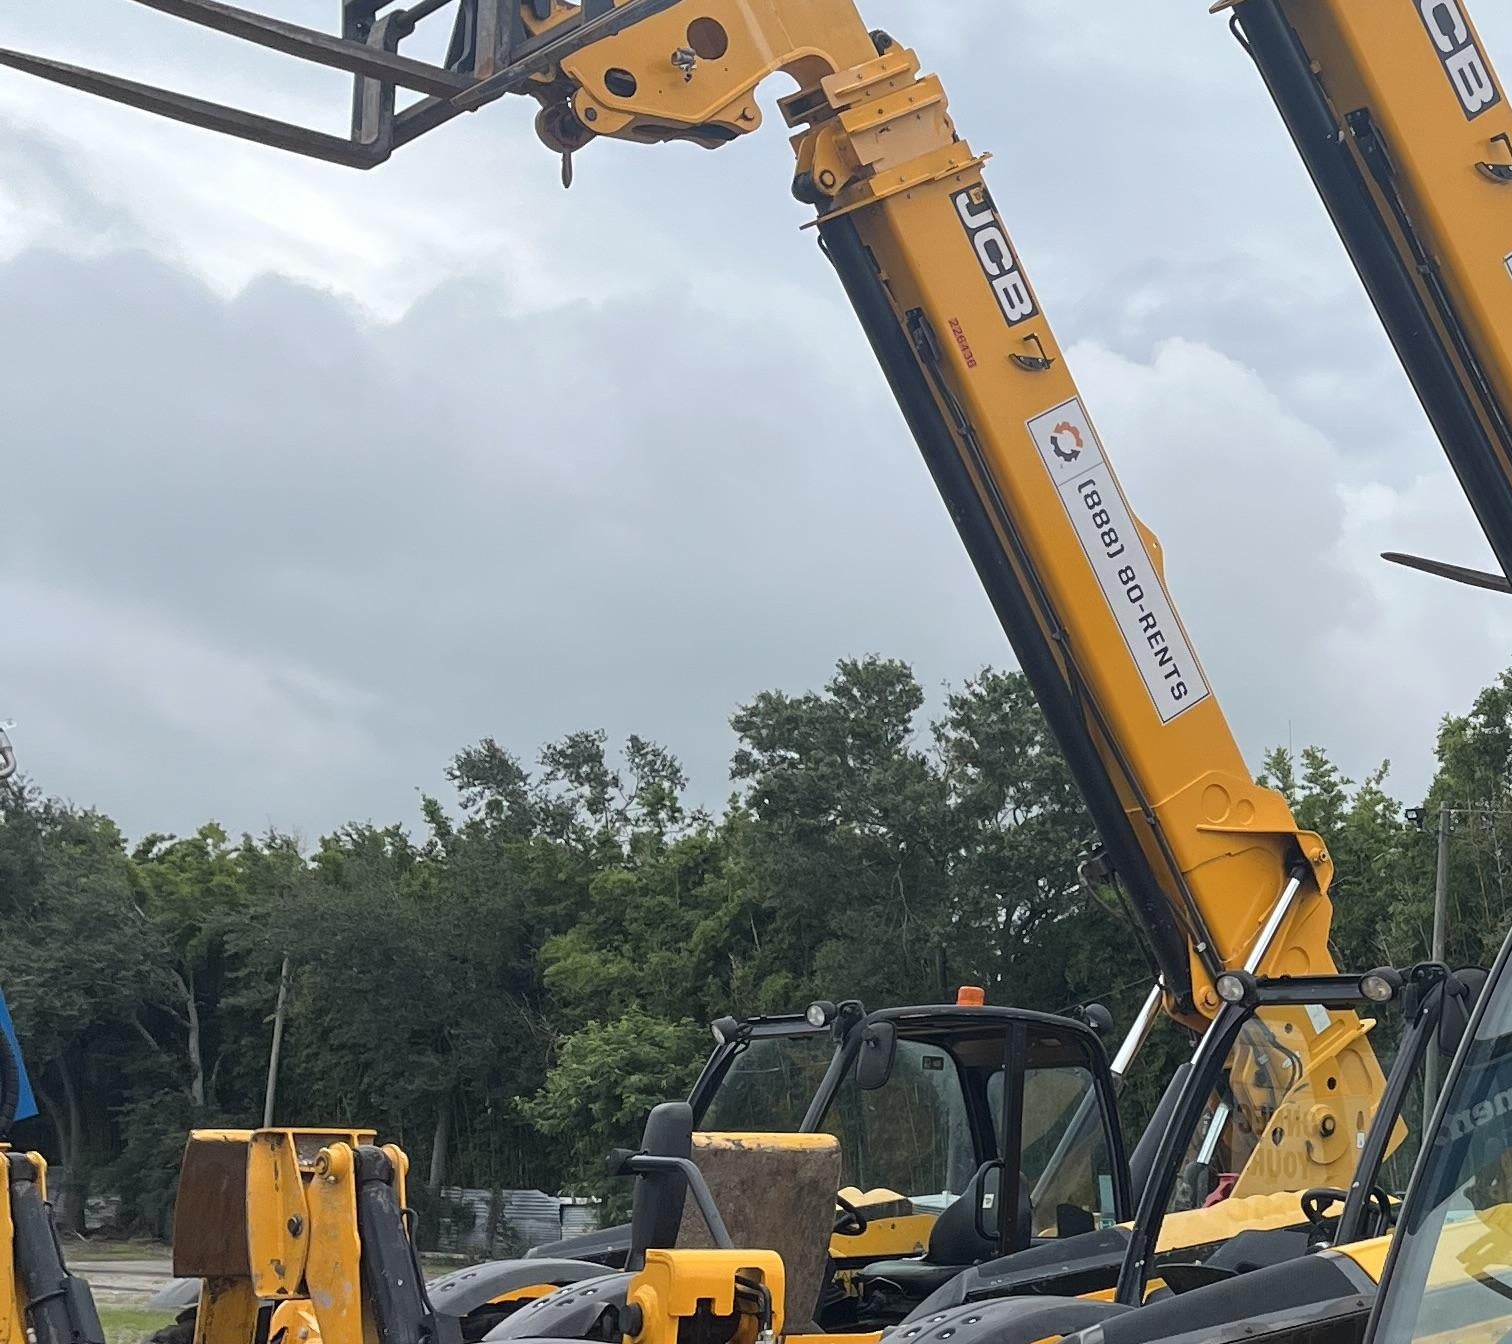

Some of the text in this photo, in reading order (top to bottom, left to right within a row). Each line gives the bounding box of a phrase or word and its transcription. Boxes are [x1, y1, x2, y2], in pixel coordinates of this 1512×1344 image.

[955, 190, 1035, 323] JCB
[1077, 477, 1189, 702] (888) 80-RENTS
